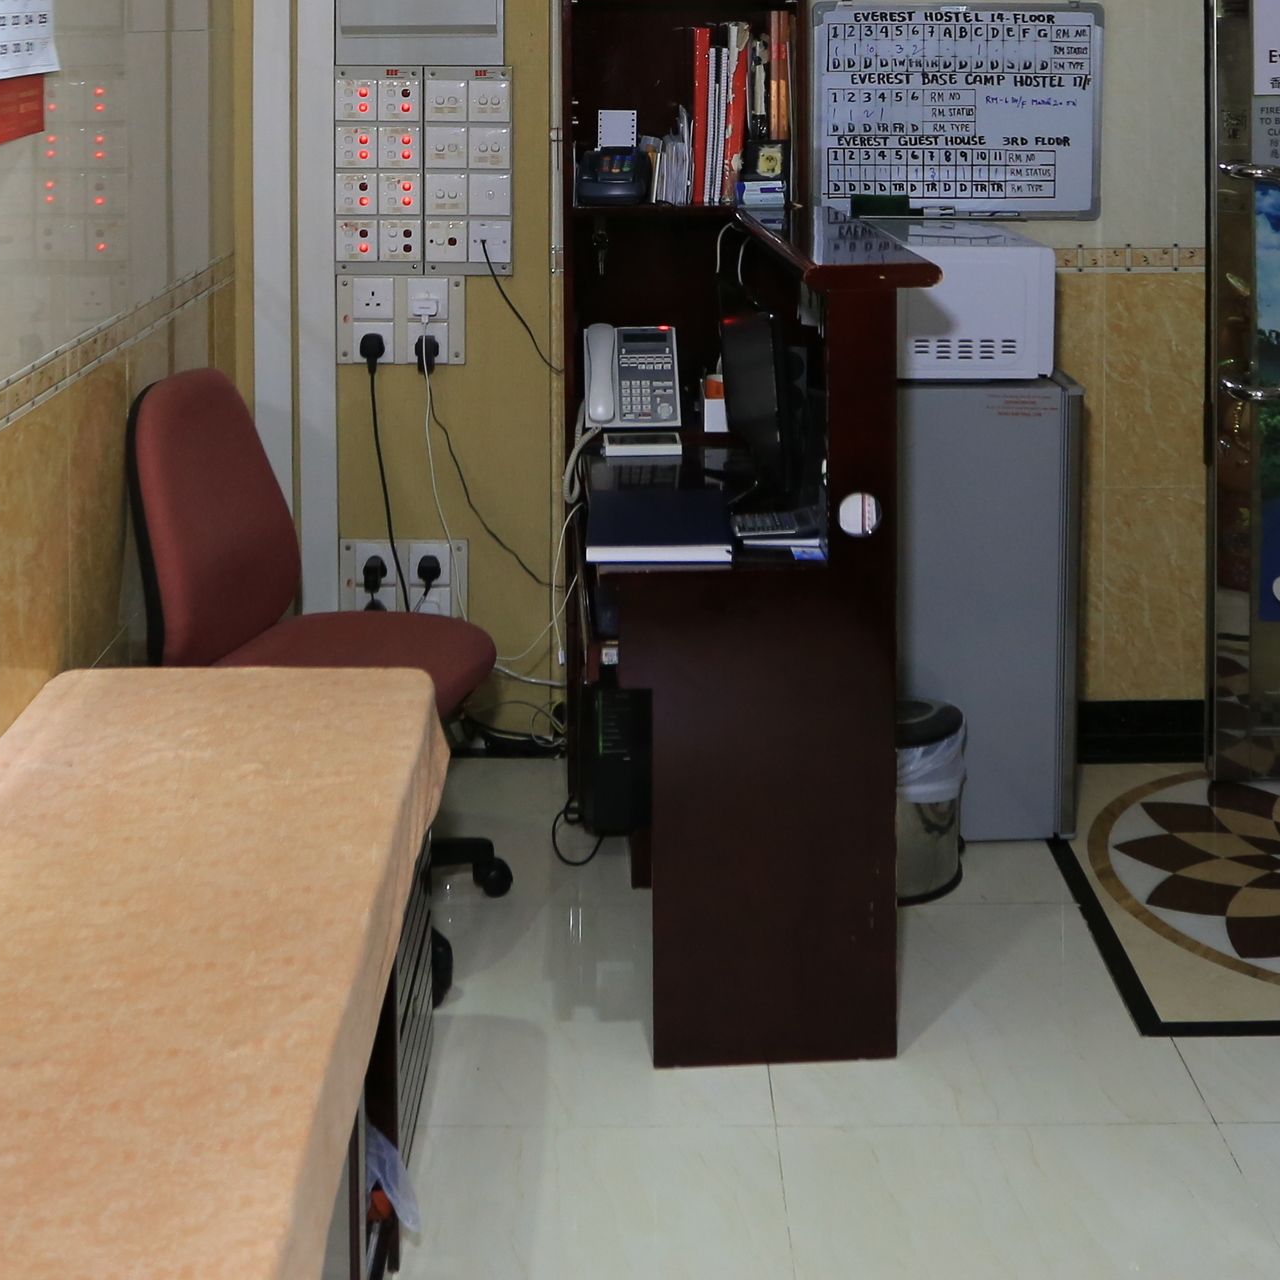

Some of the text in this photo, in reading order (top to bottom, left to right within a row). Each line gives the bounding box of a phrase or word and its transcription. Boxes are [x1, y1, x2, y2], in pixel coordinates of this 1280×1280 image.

[854, 11, 915, 23] EVEREST
[924, 11, 983, 23] HOSTEL
[831, 25, 1069, 39] 1 2 3 4 5 6 7 A B C D E F G RM
[847, 59, 855, 68] D
[1040, 60, 1048, 70] D
[1069, 61, 1084, 70] TYPE
[851, 73, 913, 85] EVEREST
[922, 73, 957, 86] BASE
[965, 74, 1005, 86] CAMP
[1014, 75, 1064, 88] HOSTEL
[832, 91, 961, 103] 1 2 3 4 5 6 RM NO
[931, 107, 974, 117] RM STATUS
[1260, 106, 1280, 114] FIRE
[1260, 117, 1272, 125] TO
[832, 123, 970, 133] D D D FR FR D RM TYPE
[837, 135, 1071, 147] EVEREST GUEST HOUSE 3RD FLOOR
[833, 150, 1036, 162] 1 2 3 4 5 6 7 8 9 10 11 RM NO
[1010, 168, 1051, 177] RM STATUS
[833, 183, 840, 192] D
[849, 183, 856, 192] D
[864, 183, 871, 191] D
[879, 183, 887, 192] D
[893, 182, 904, 192] TR
[910, 183, 917, 192] D
[926, 183, 938, 192] TR
[943, 183, 951, 192] D
[960, 183, 967, 192] D
[975, 183, 987, 192] TR
[991, 183, 1004, 192] TR
[1027, 184, 1043, 192] TYPE
